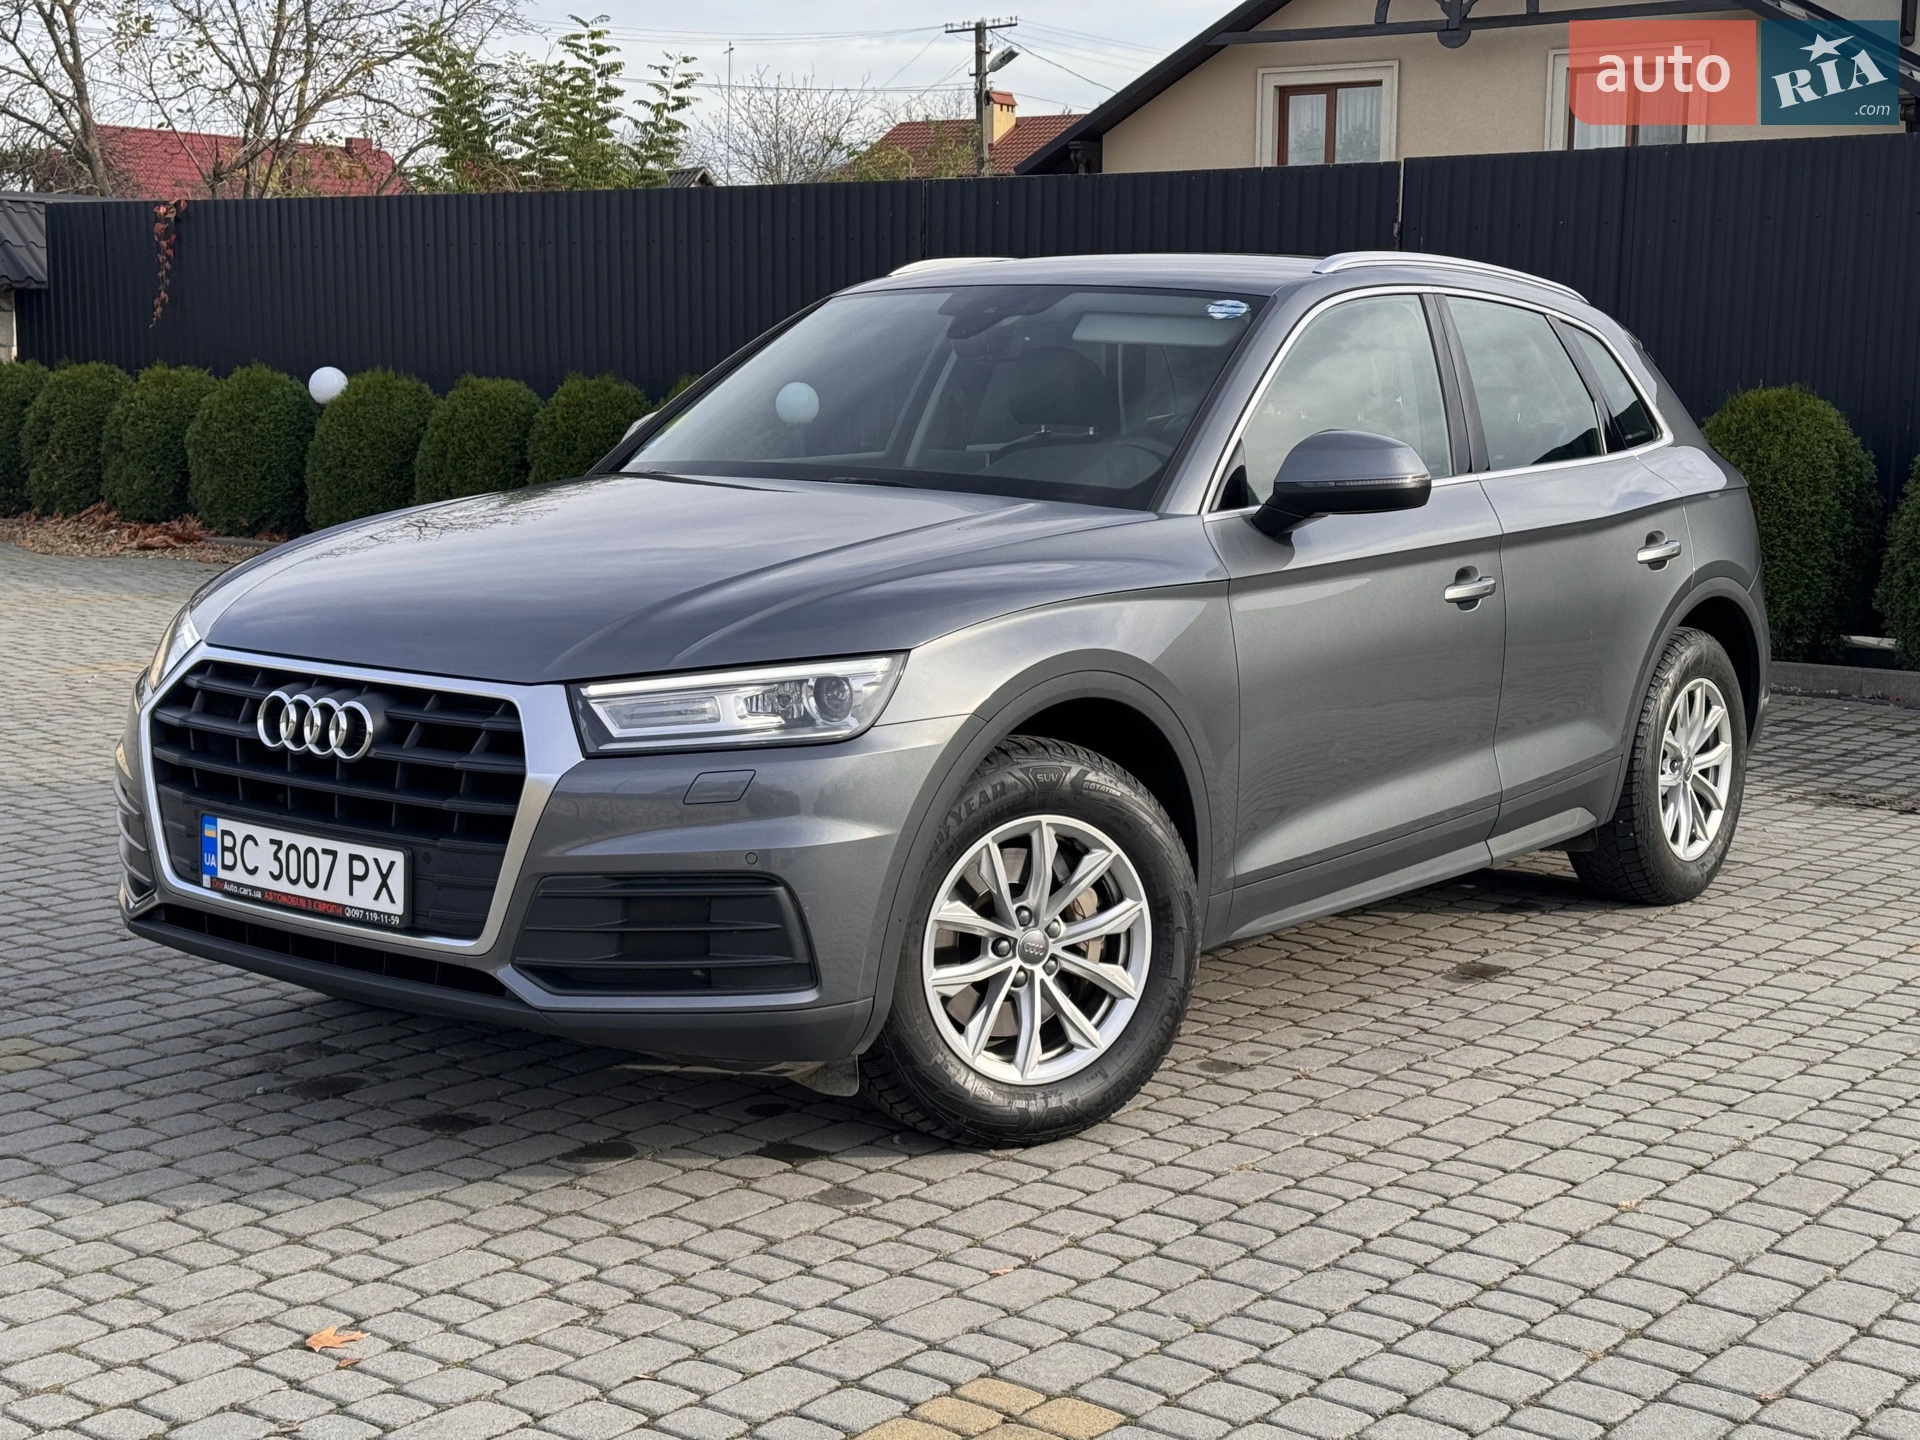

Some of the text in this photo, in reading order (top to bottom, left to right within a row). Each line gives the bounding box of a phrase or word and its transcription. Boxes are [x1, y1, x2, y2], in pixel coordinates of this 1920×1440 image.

[1036, 772, 1059, 783] SUV
[1082, 781, 1122, 797] ROTATION
[204, 853, 217, 867] UA
[220, 829, 397, 904] BC 3007 PX
[365, 911, 400, 925] 119-11-59
